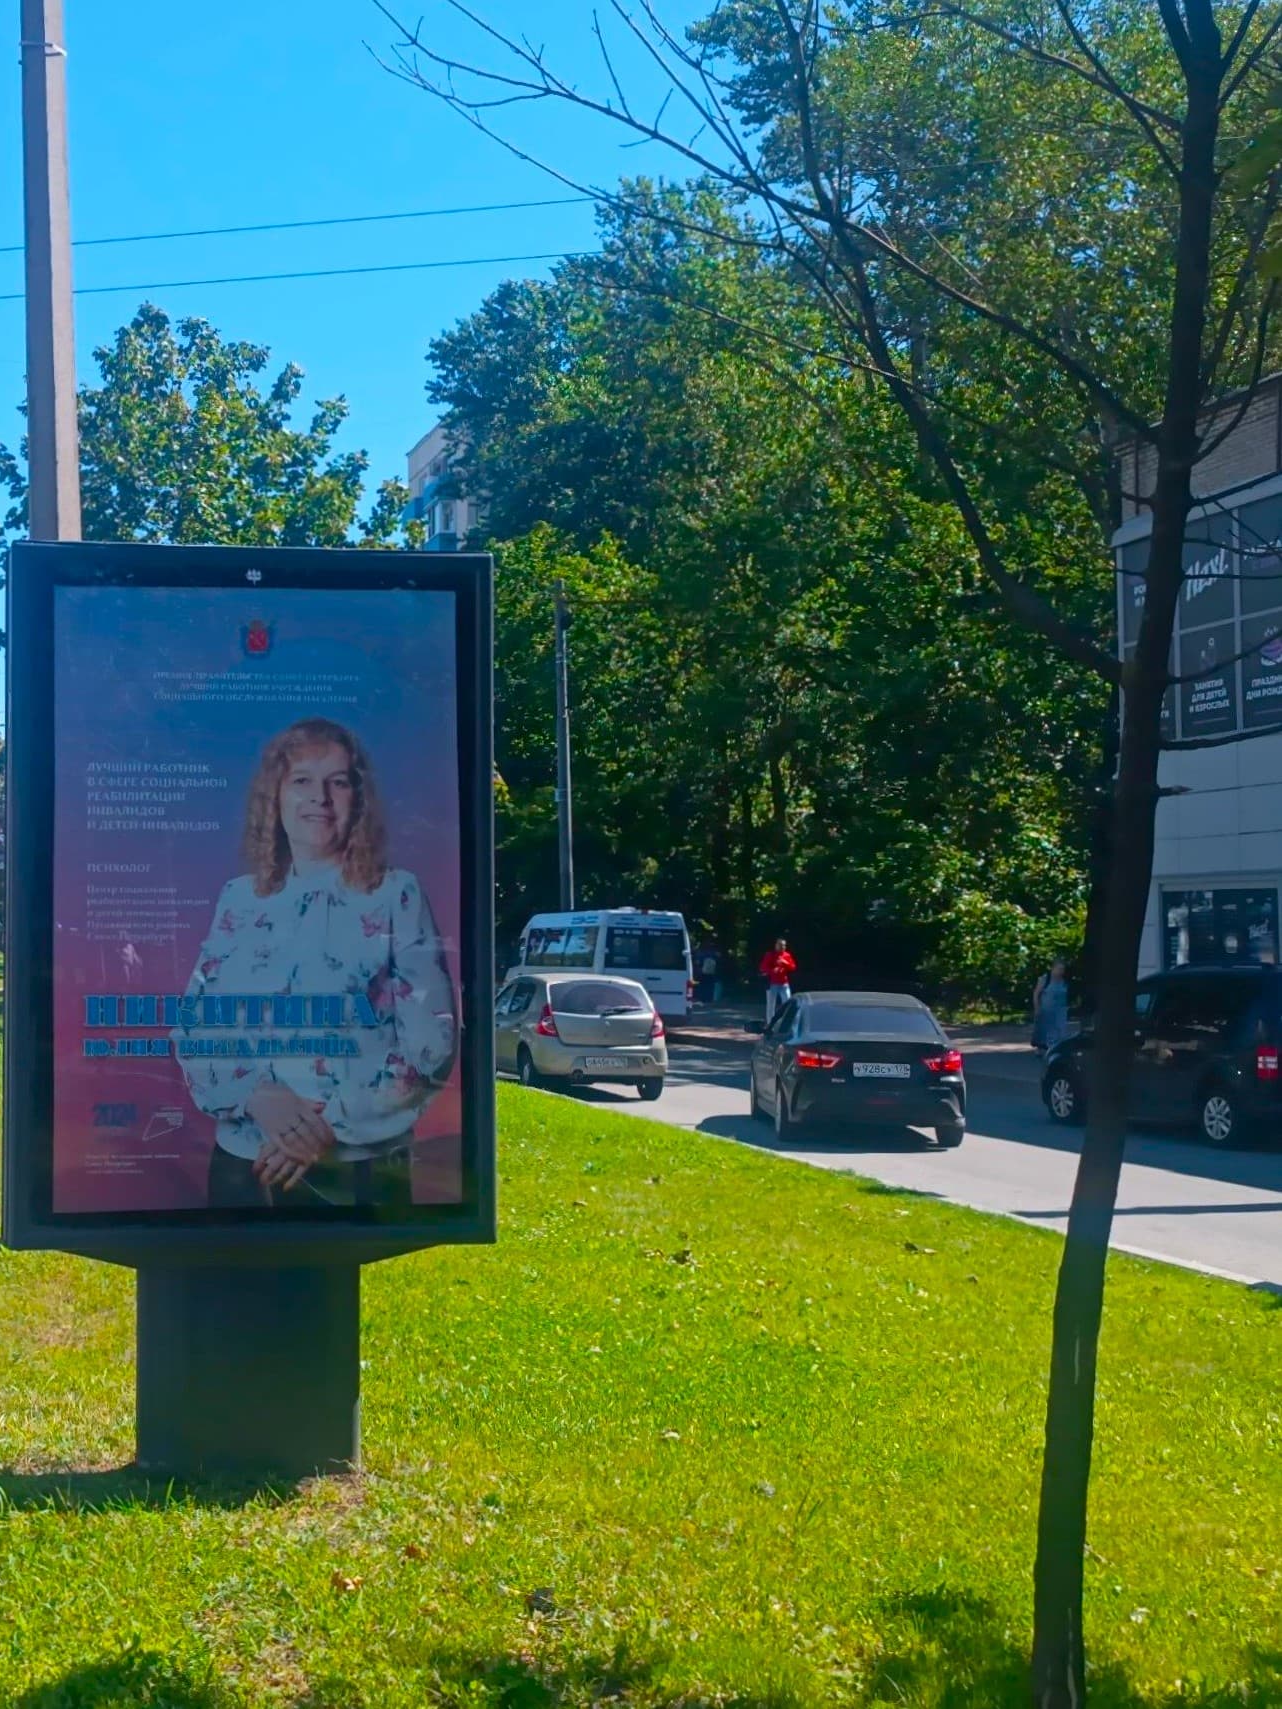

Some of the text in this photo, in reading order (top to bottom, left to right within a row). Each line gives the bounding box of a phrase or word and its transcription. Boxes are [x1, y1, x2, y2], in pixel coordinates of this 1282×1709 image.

[87, 762, 210, 774] ЛУЧШИЙ РАБОТНИК
[97, 777, 138, 787] СФЕРЕ
[141, 776, 227, 788] СОЦИАЛЬНОЙ
[87, 791, 186, 803] РЕАБИЛИТАЦИИ
[87, 806, 165, 817] ИНВАЛИДОВ
[87, 863, 151, 873] ПСИХОЛОГ
[84, 994, 379, 1027] НИКИТИНА
[84, 1038, 170, 1057] ЮЛИЯ
